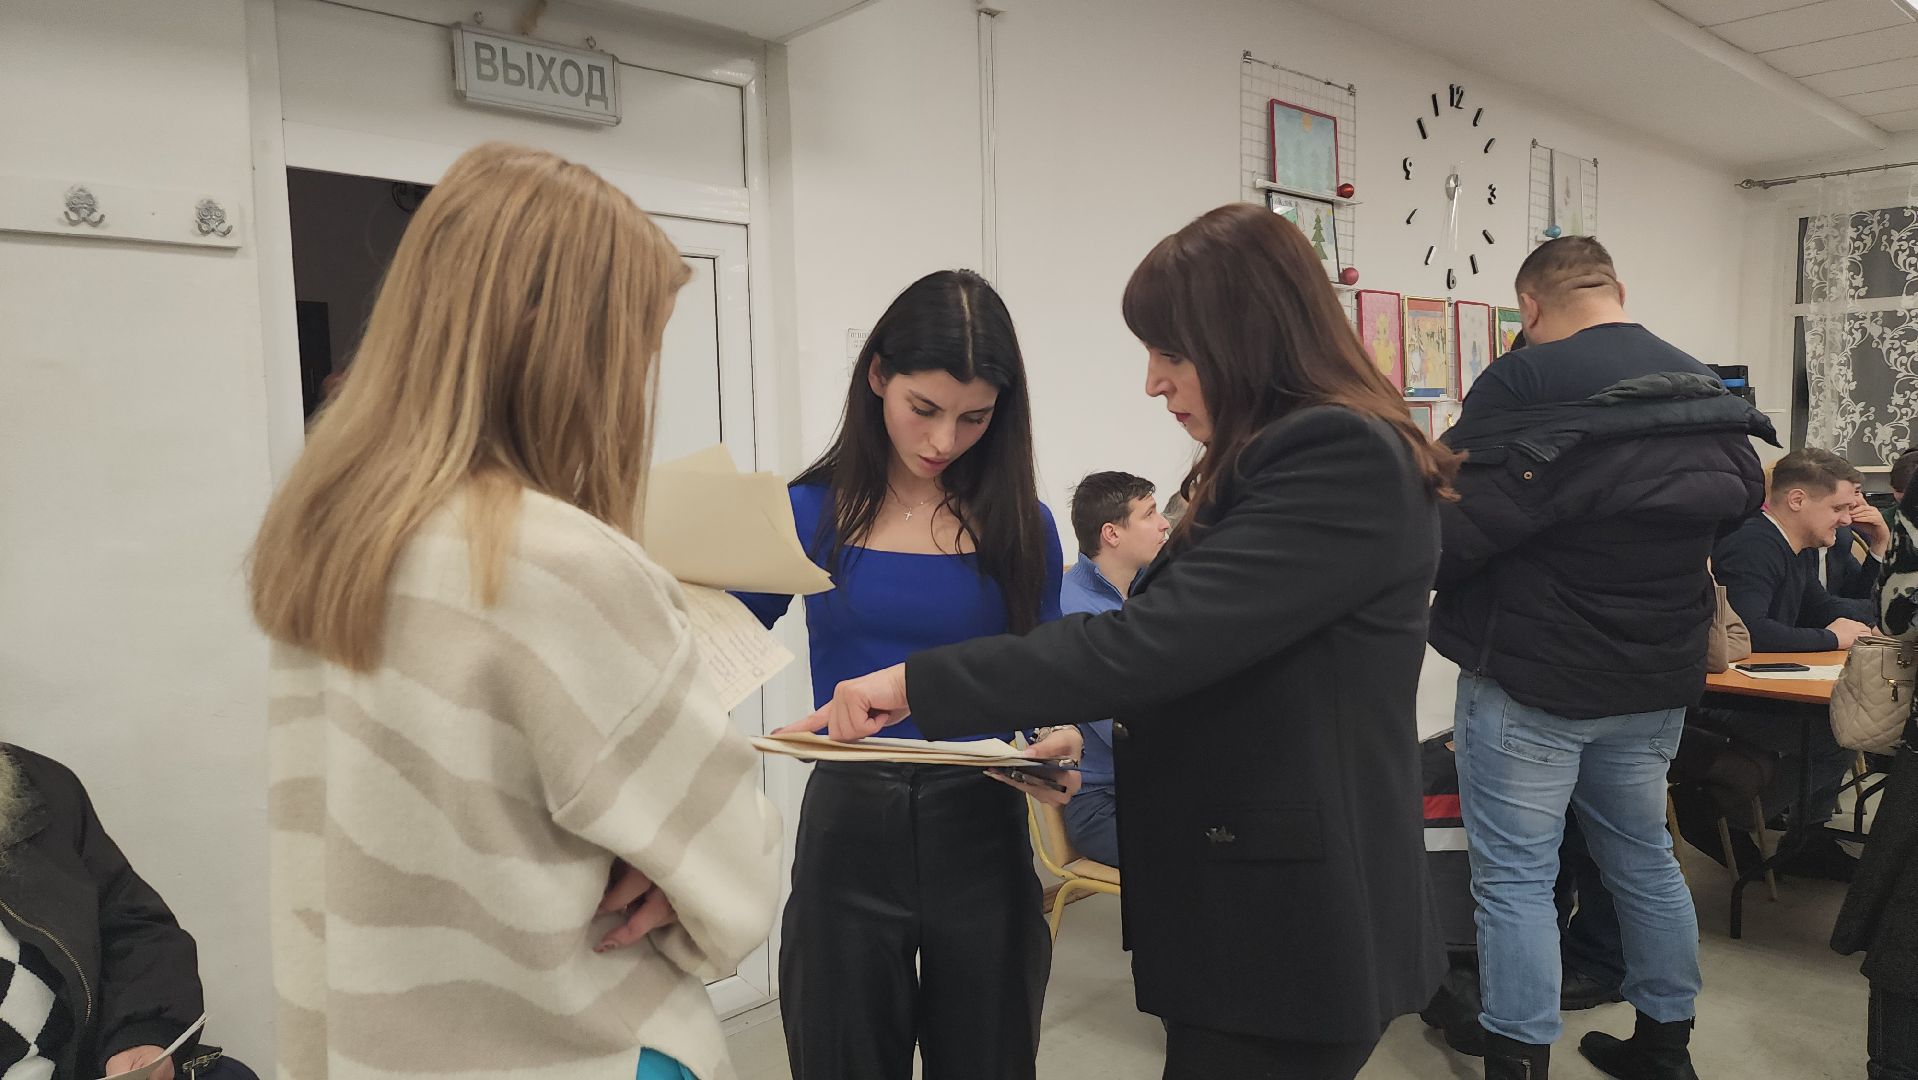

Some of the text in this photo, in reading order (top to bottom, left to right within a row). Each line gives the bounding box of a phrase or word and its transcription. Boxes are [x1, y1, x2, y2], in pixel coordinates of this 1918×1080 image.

[474, 41, 609, 110] ВЫХОД
[1449, 83, 1464, 110] 12
[1446, 268, 1457, 290] 6
